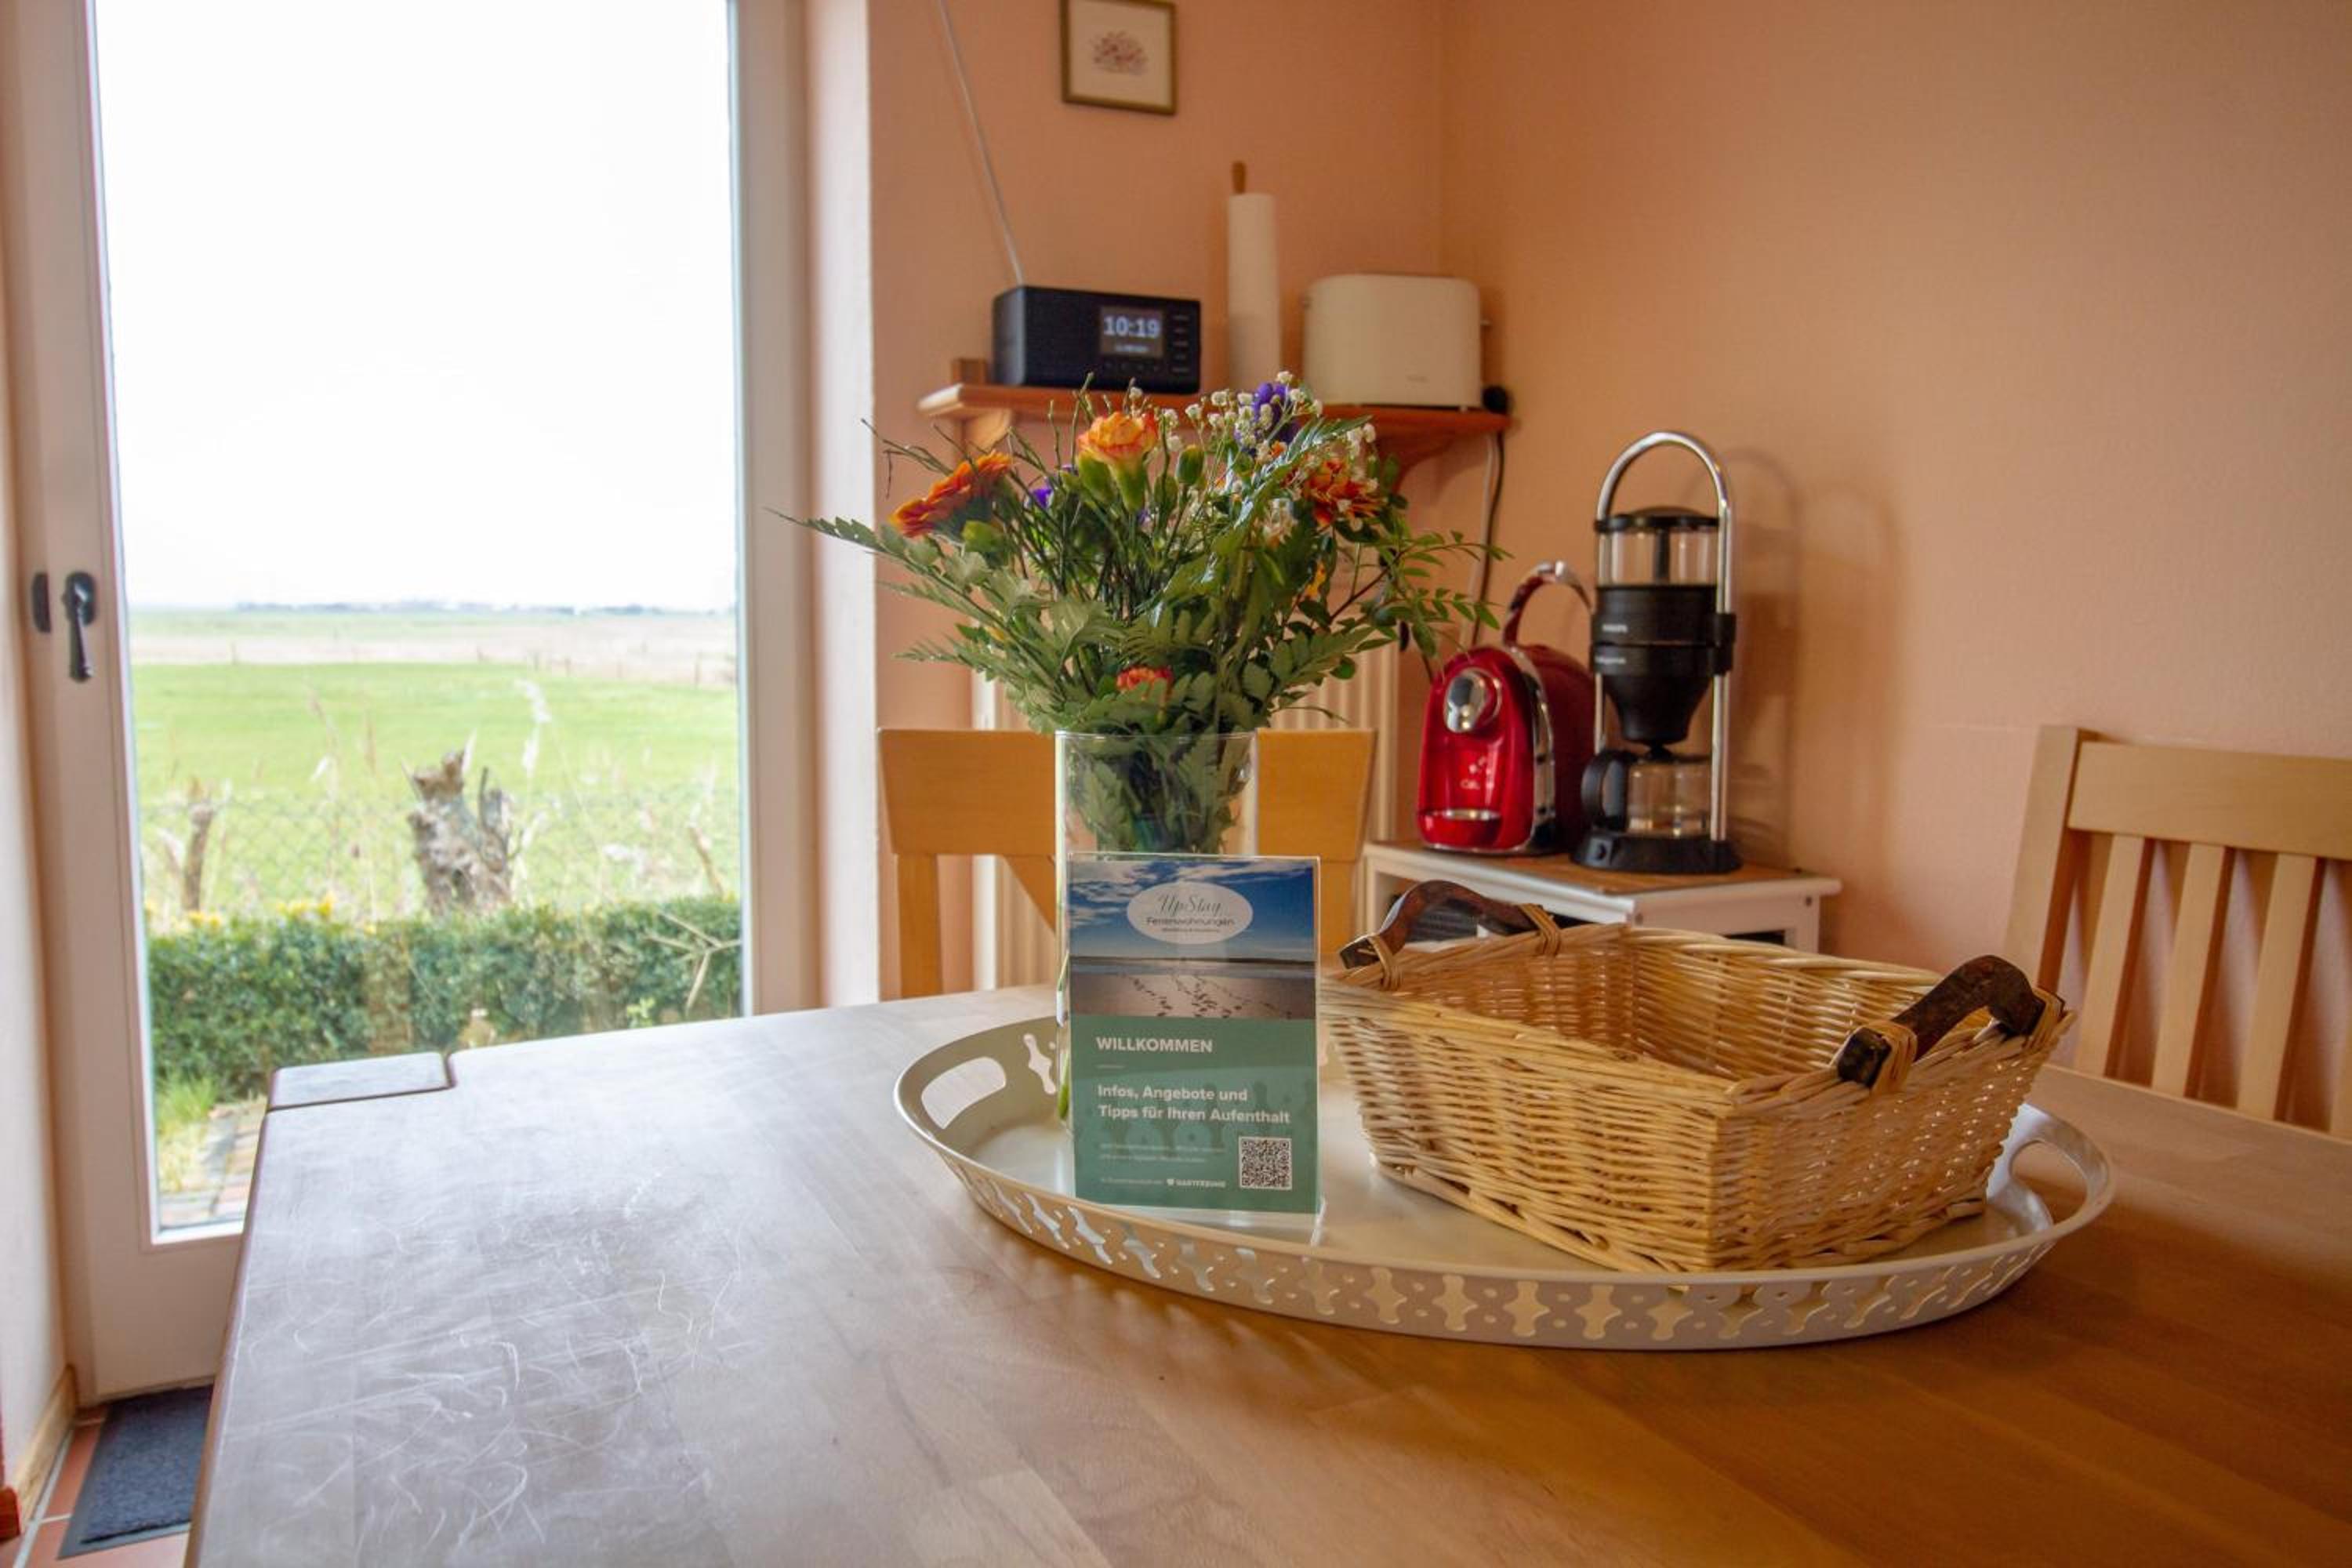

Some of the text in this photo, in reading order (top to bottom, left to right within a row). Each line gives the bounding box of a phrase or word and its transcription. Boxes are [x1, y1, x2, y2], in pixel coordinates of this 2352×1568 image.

[1103, 316, 1160, 339] 10:19
[1146, 916, 1235, 927] Ferienwohnungen
[1096, 1037, 1214, 1052] WILLKOMMEN
[1098, 1084, 1247, 1102] Infos, Angebote und
[1098, 1104, 1290, 1123] Tipps für Ihren Aufenthalt
